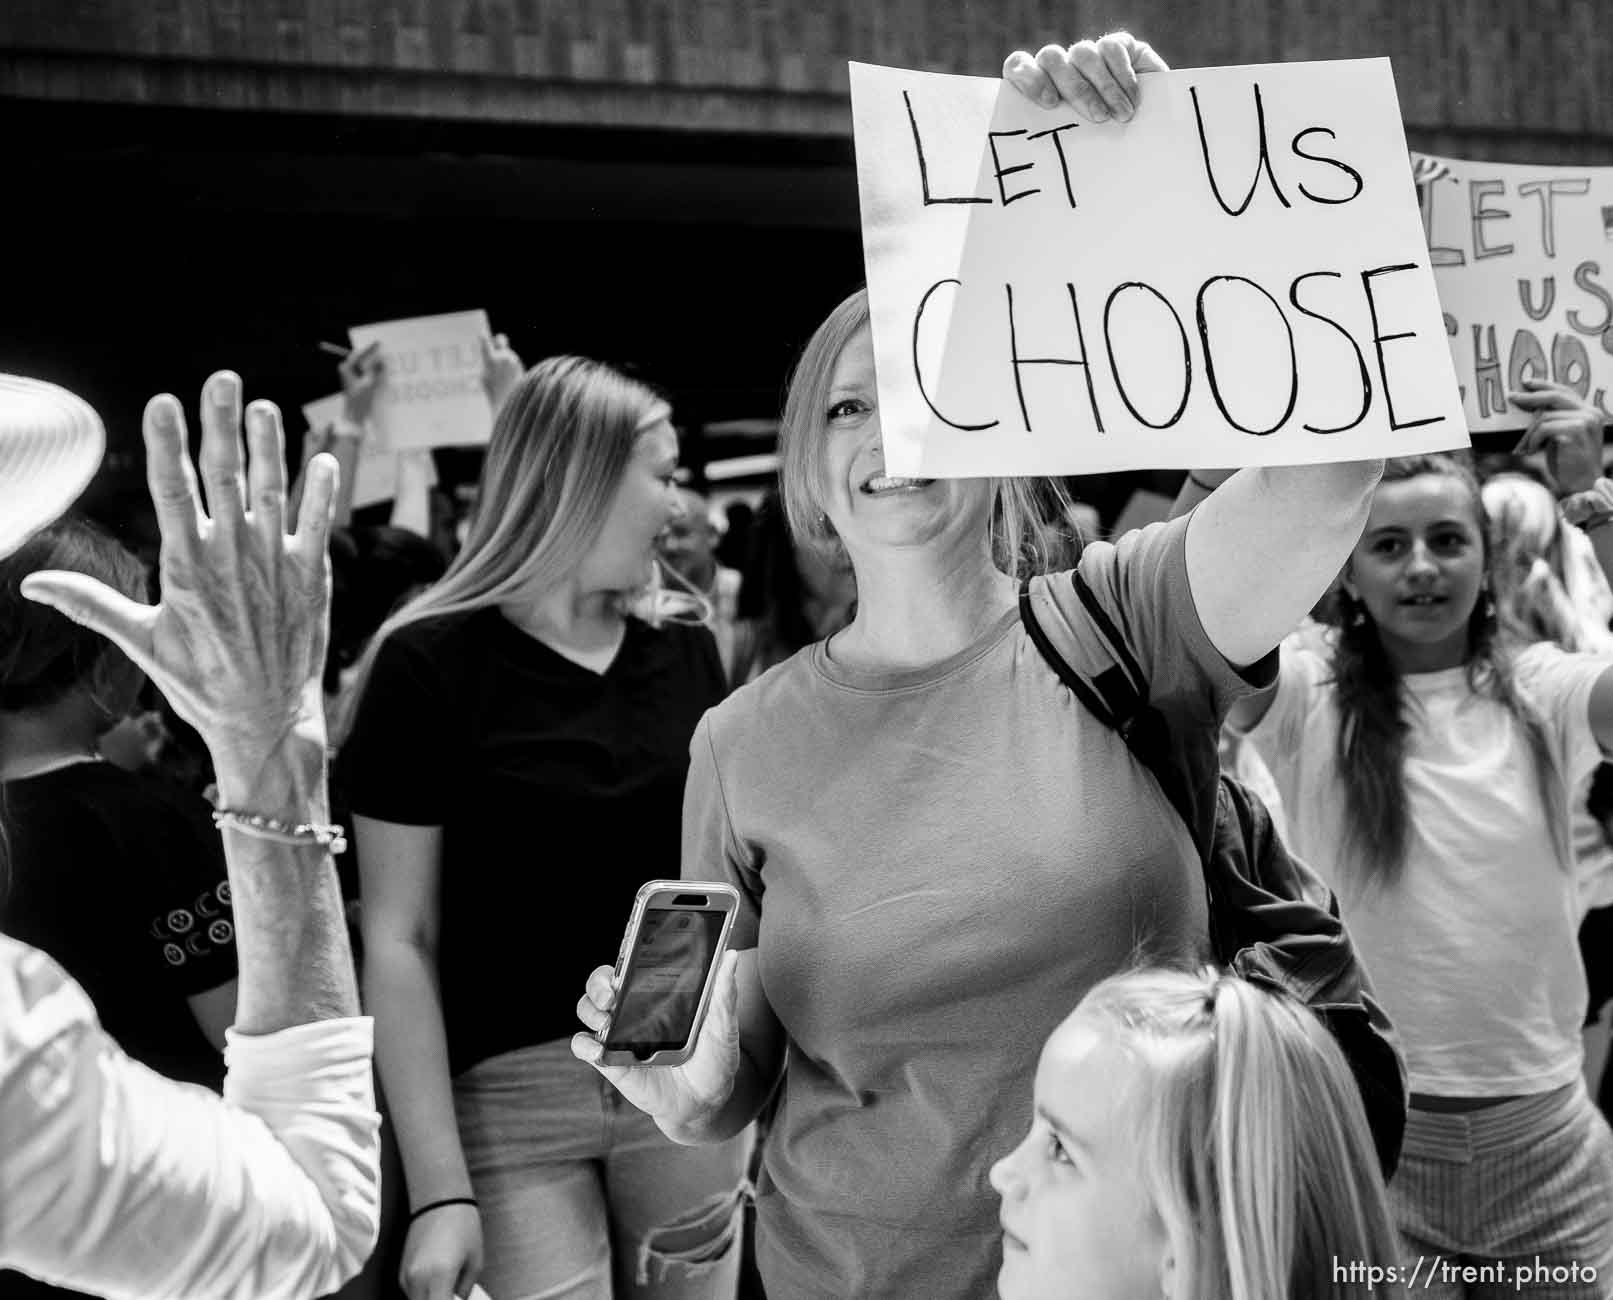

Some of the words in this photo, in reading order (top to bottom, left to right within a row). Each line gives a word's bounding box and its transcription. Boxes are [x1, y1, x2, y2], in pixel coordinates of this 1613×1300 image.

[903, 89, 1079, 208] LET
[912, 262, 1447, 436] CHOOSE
[1517, 260, 1613, 336] US
